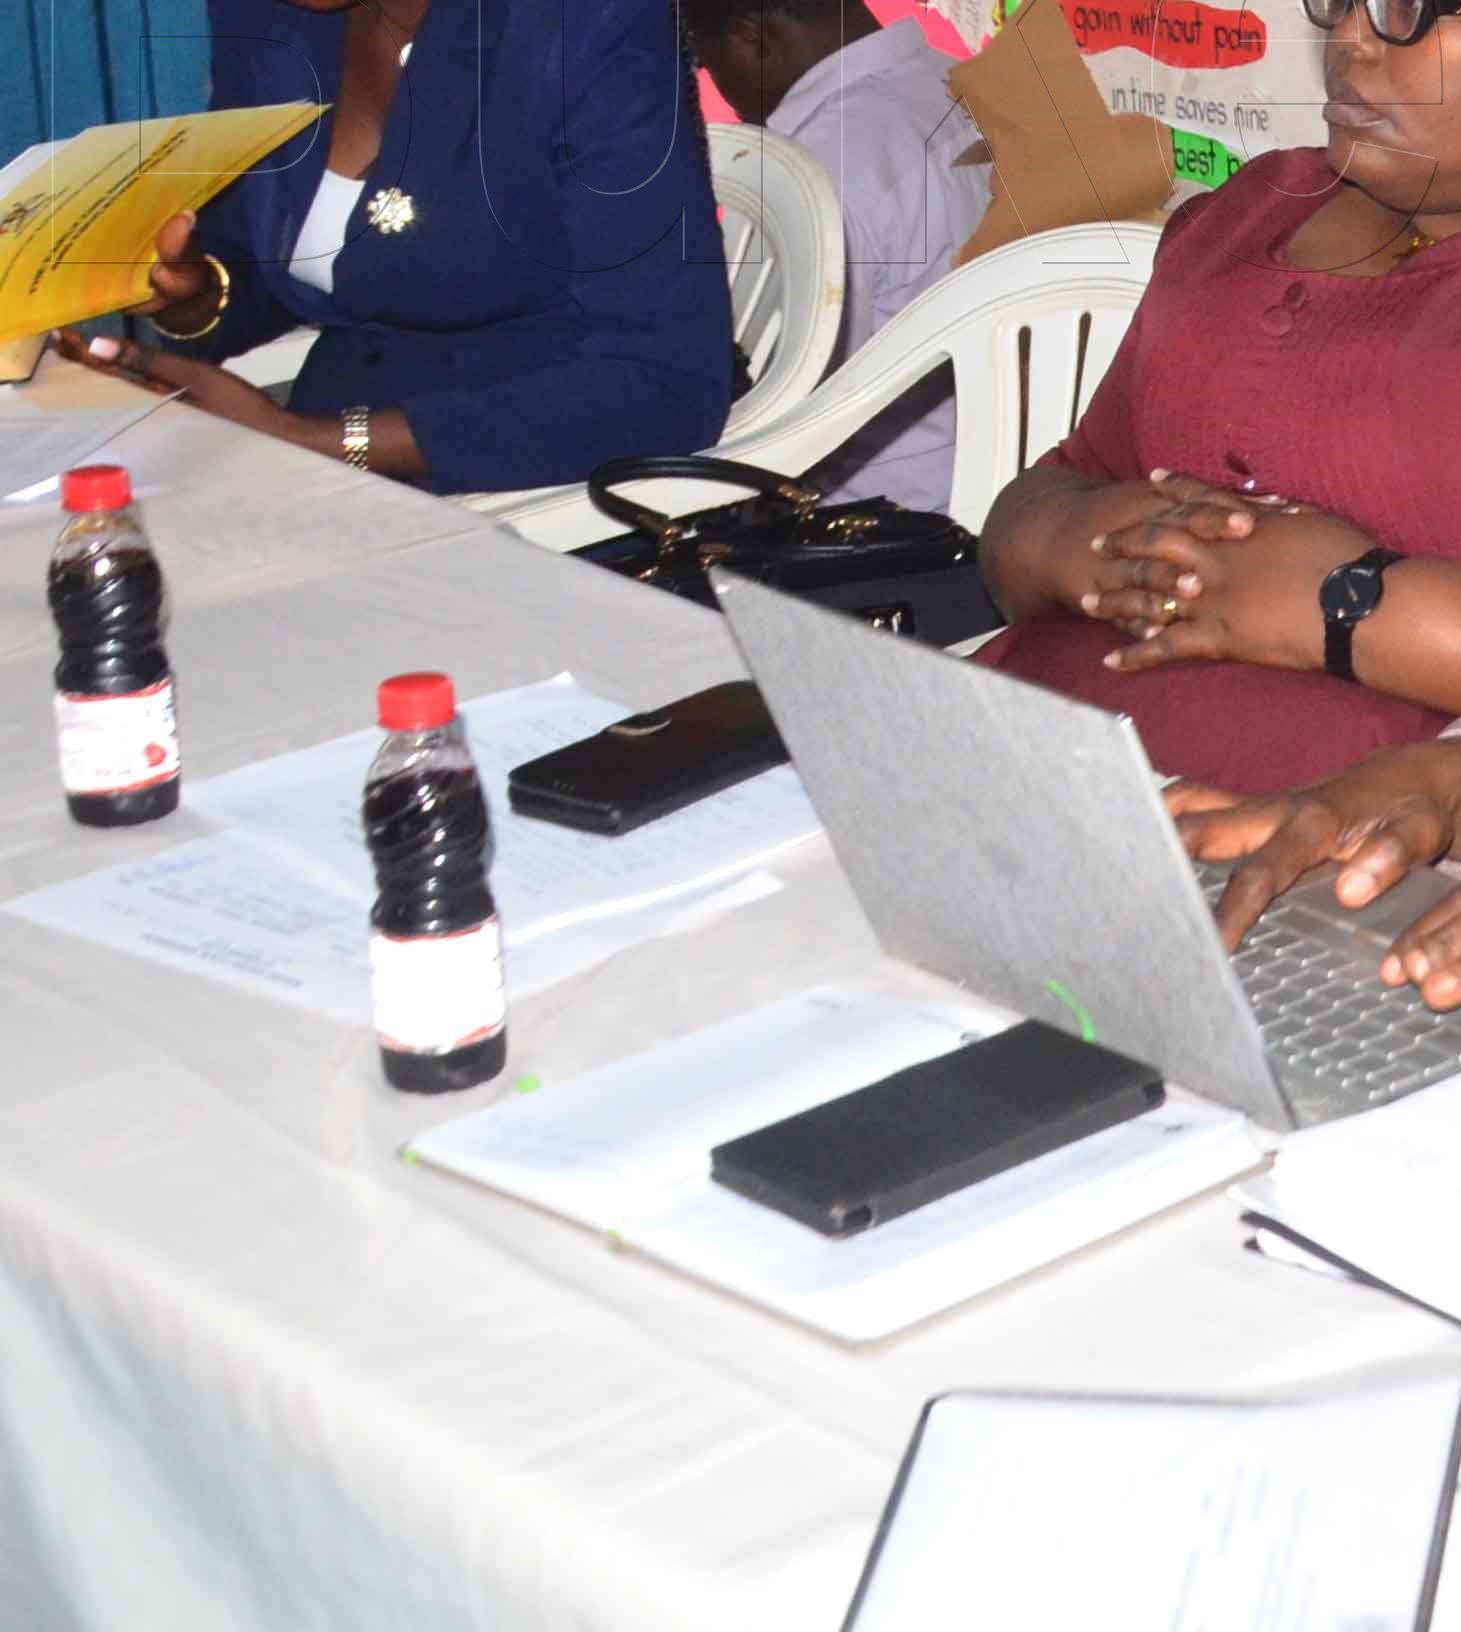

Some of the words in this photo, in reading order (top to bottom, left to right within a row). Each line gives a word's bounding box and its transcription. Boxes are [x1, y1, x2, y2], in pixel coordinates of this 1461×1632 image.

[1073, 4, 1121, 48] gain
[1130, 2, 1204, 46] without
[1215, 16, 1262, 65] pain
[1130, 77, 1167, 117] time
[1175, 94, 1228, 127] saves
[1234, 103, 1270, 133] nine
